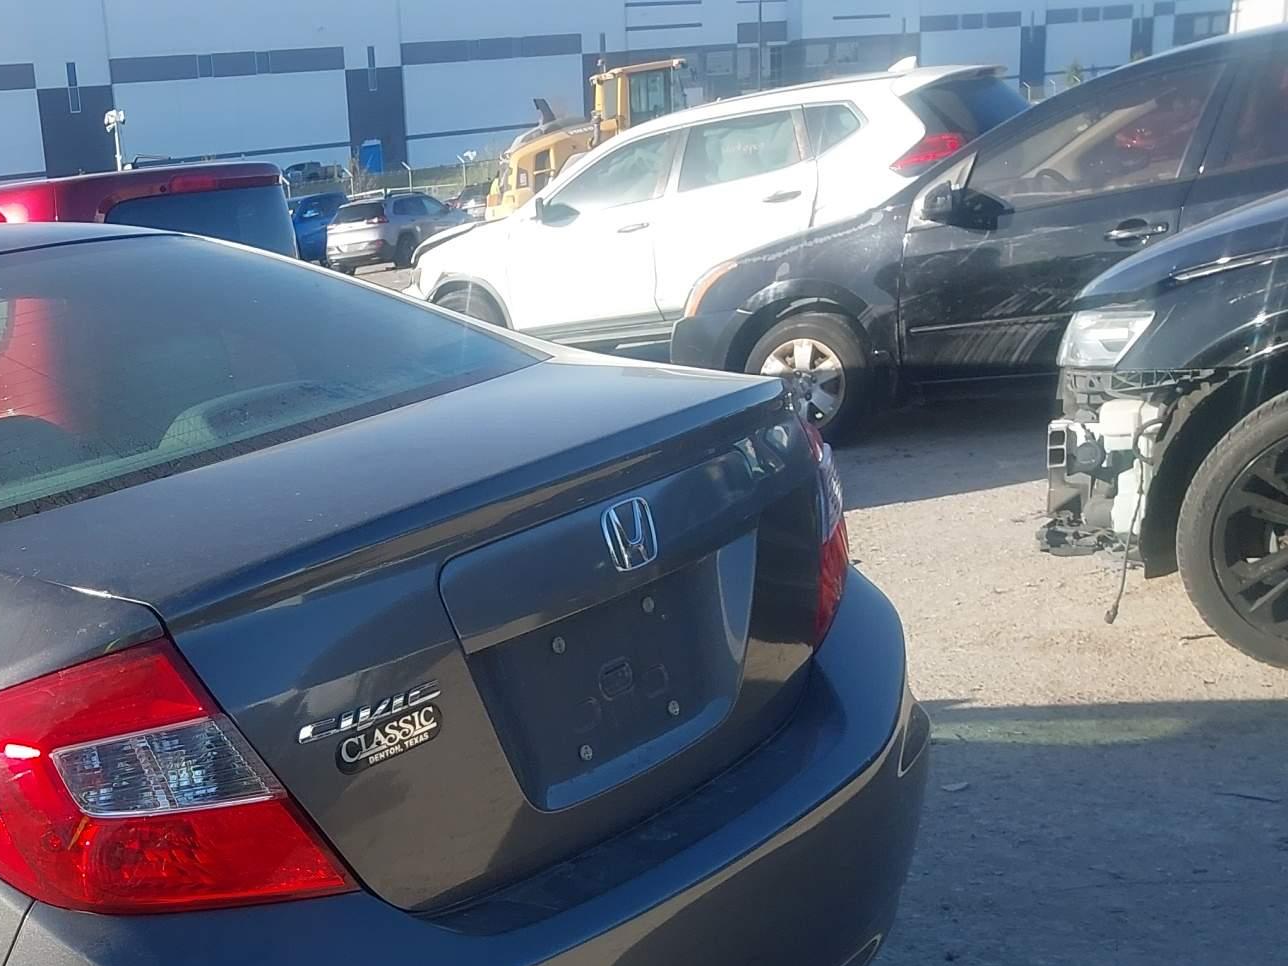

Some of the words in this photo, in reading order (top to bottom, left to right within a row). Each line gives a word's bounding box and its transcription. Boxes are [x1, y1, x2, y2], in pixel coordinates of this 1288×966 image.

[298, 679, 441, 745] CIVIC
[341, 706, 438, 763] CLASSIC
[403, 732, 430, 749] TEXAS
